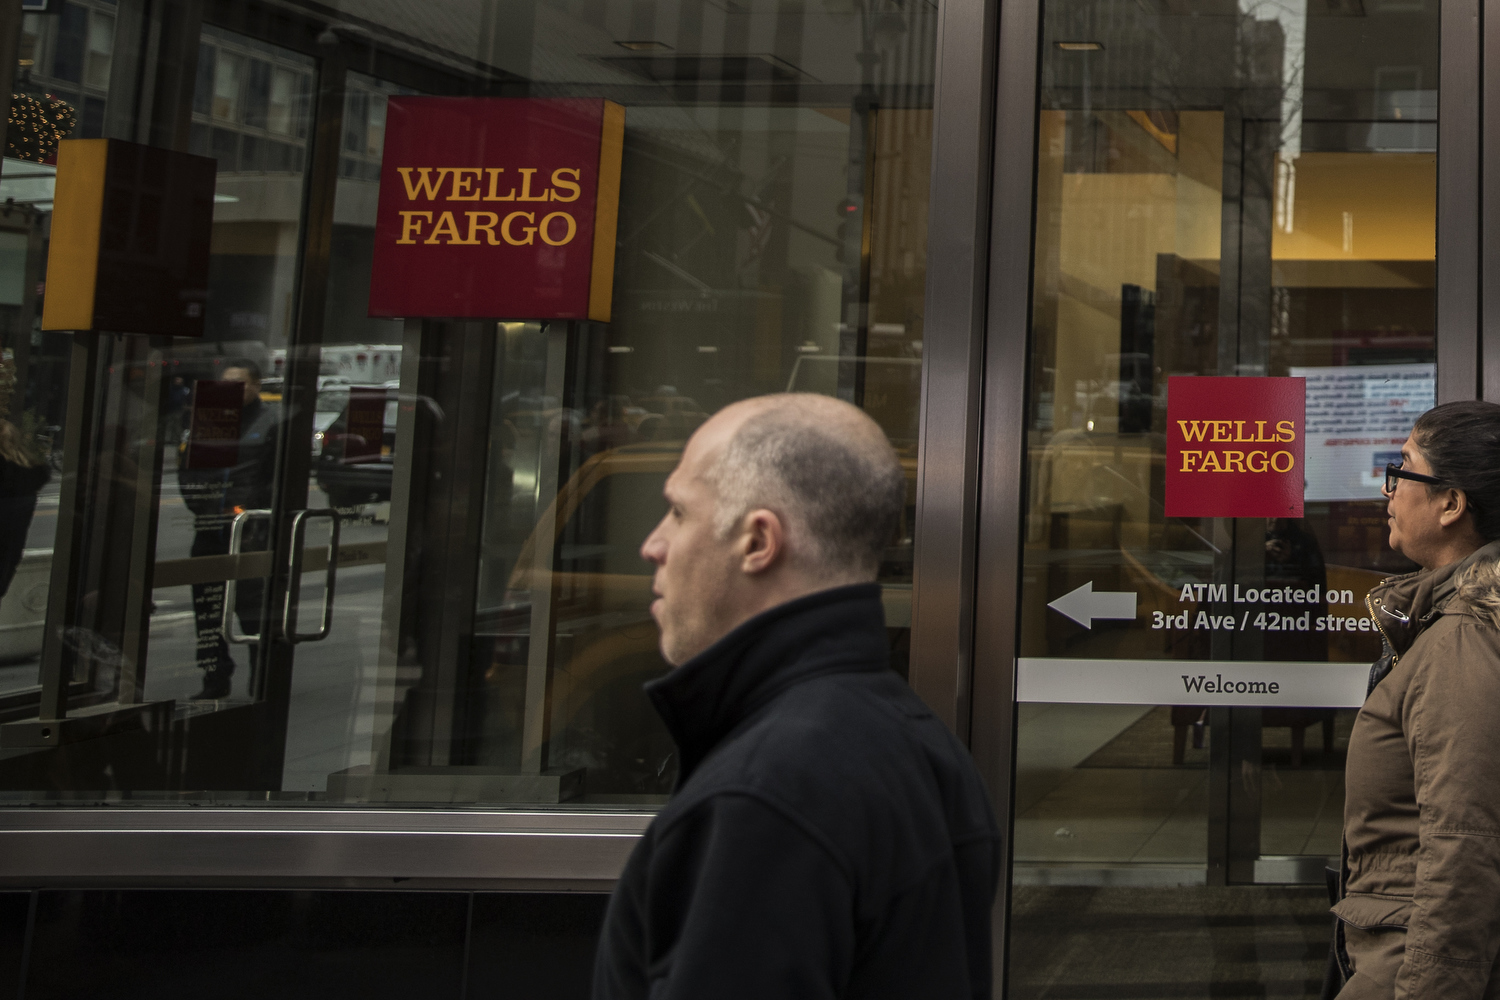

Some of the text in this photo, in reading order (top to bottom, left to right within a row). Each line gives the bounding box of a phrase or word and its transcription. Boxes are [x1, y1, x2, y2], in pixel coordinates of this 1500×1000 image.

[397, 167, 582, 203] WELLS
[397, 210, 577, 248] FARGO
[1177, 419, 1296, 443] WELLS
[1179, 450, 1295, 473] FARGO
[1179, 582, 1354, 605] ATM Located on
[1151, 609, 1189, 631] 3rd
[1194, 611, 1236, 631] Ave
[1253, 611, 1311, 631] 42nd
[1315, 613, 1379, 632] street
[1182, 675, 1280, 694] Welcome
